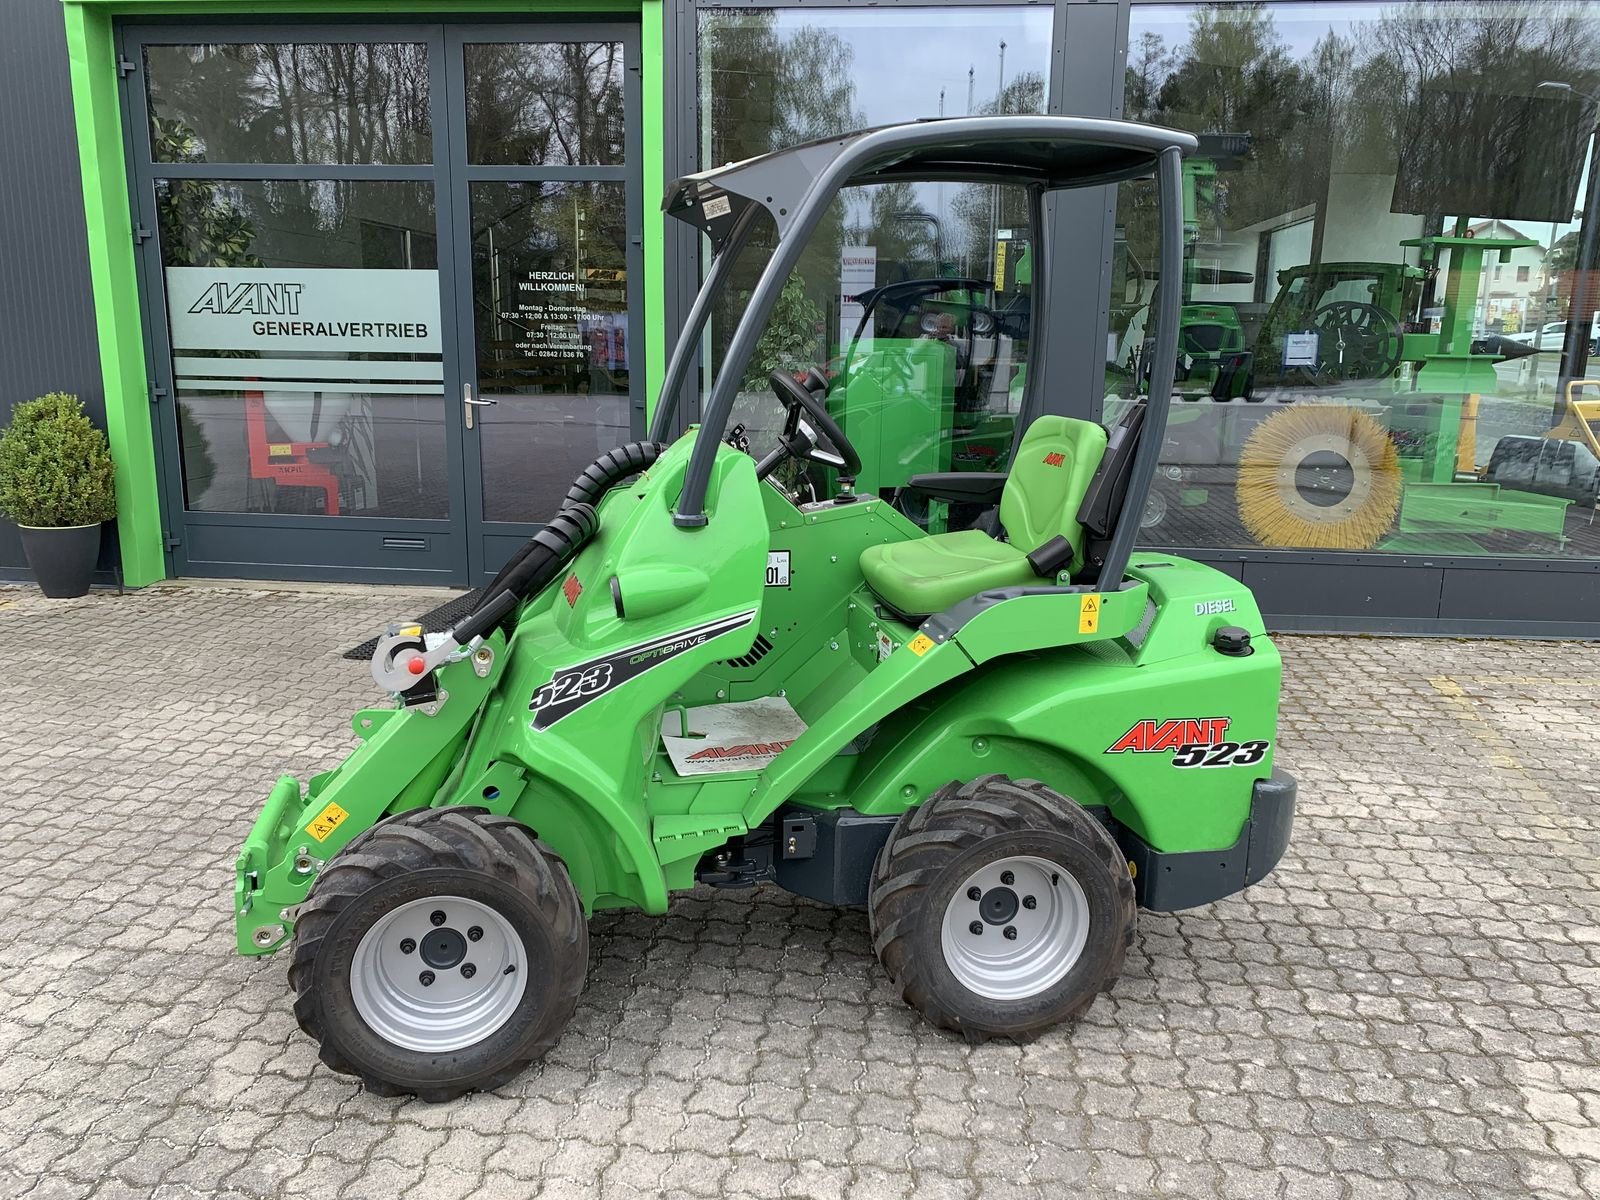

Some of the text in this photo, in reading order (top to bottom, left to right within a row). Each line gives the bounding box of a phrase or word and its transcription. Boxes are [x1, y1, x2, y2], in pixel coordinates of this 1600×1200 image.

[529, 272, 575, 280] HERZLICH
[519, 283, 585, 292] WILLKOMMEN!
[187, 282, 302, 315] AVANT
[519, 304, 543, 312] Montag
[548, 305, 587, 313] Donnerstag
[252, 321, 428, 338] GENERALVERTRIEB
[540, 323, 566, 331] Freitag:
[548, 343, 592, 351] Vereinbarung
[1194, 599, 1237, 616] DIESEL
[629, 634, 708, 665] OPTIDRIVE
[528, 662, 614, 712] 523
[1103, 716, 1231, 754] AVANT
[1171, 740, 1270, 768] 523
